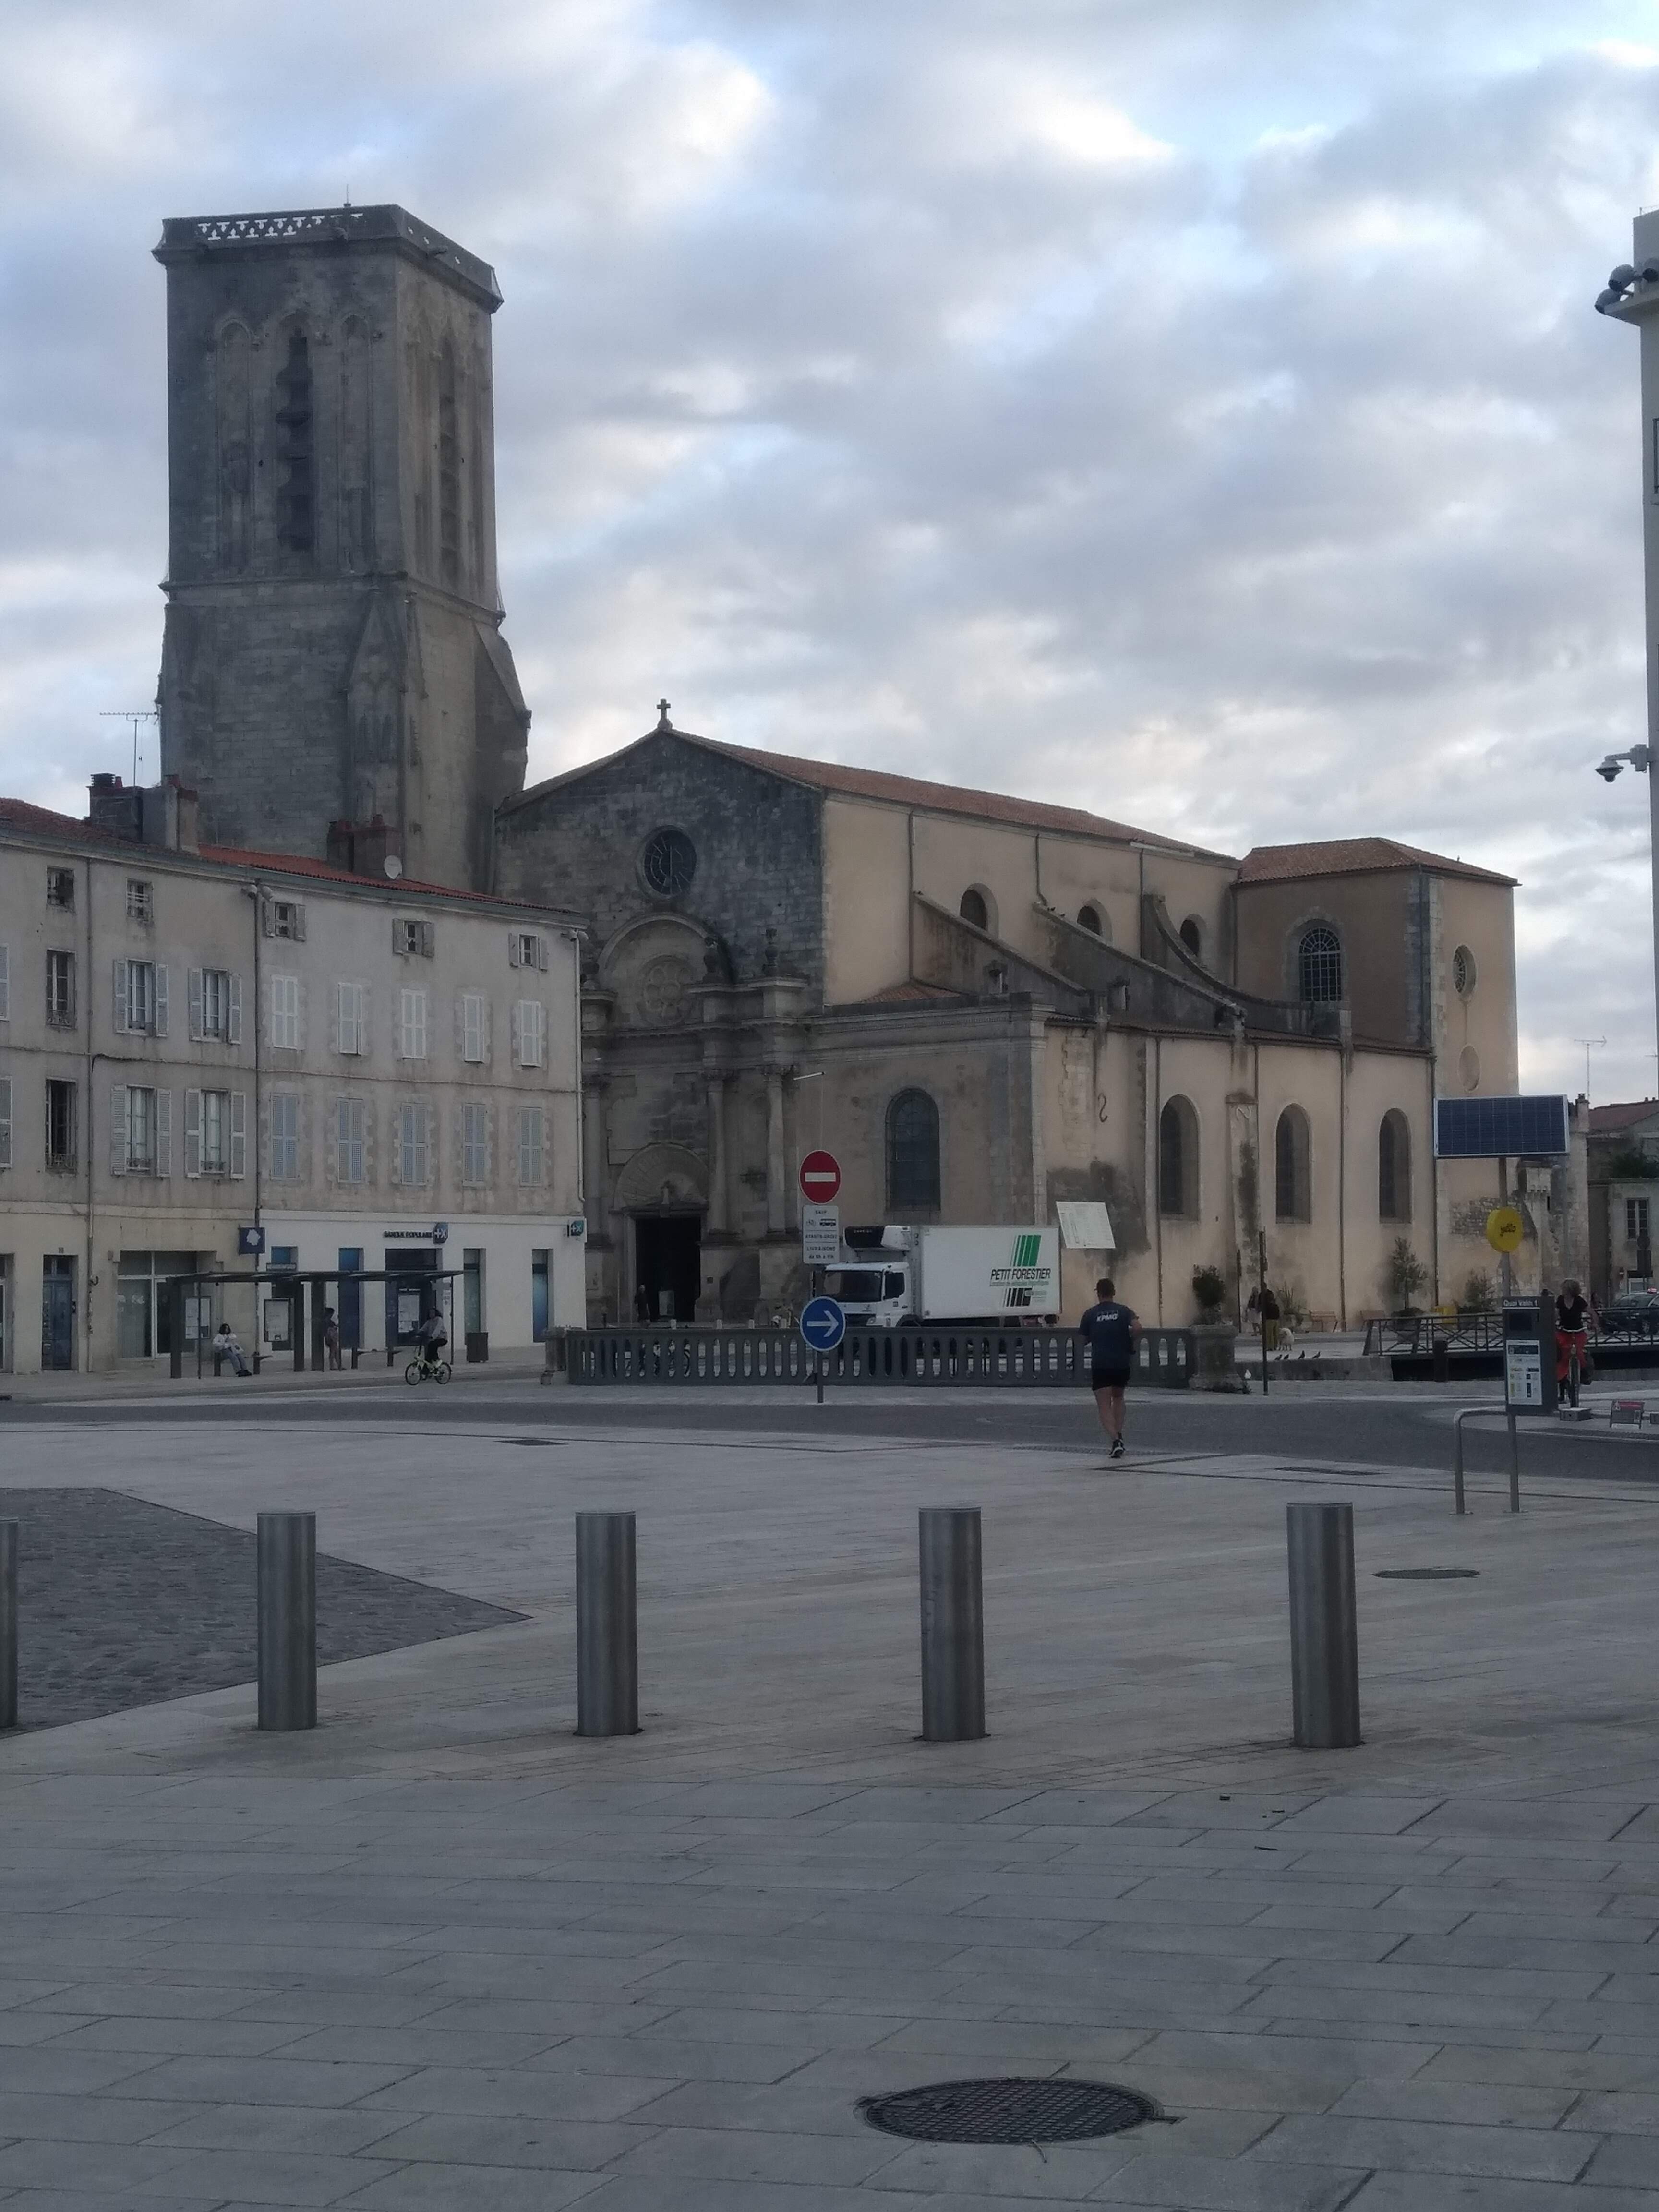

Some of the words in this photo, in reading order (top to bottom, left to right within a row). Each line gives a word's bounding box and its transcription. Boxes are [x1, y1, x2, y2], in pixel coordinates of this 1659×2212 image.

[990, 1269, 1011, 1280] PETIT
[1011, 1268, 1051, 1280] FORESTIER
[1096, 1313, 1118, 1322] KPMG
